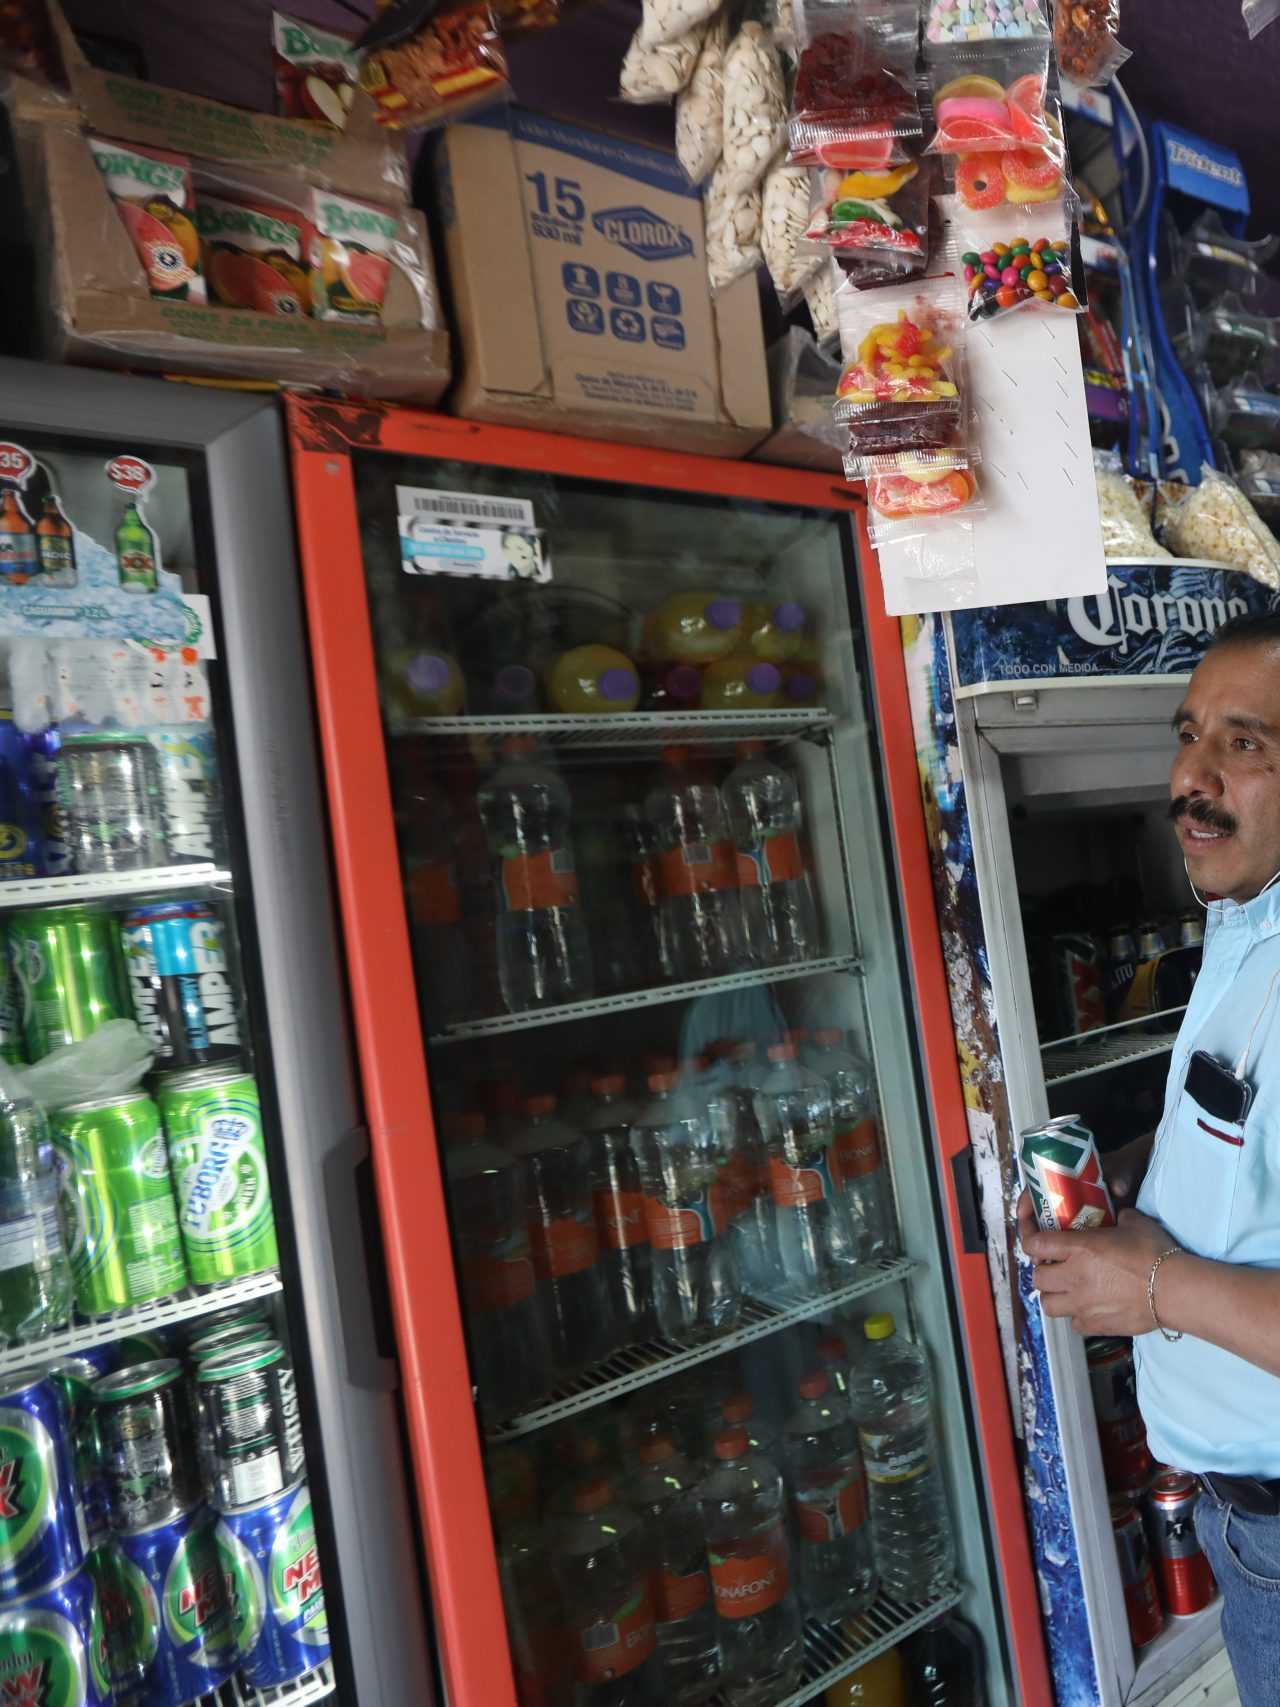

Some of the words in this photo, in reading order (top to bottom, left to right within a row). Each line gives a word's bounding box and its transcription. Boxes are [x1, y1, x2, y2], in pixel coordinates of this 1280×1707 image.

[97, 152, 186, 188] OING!
[1168, 140, 1242, 188] Trident
[525, 171, 585, 222] 15
[603, 218, 684, 249] CLOROX
[1000, 664, 1030, 675] TODO
[1033, 664, 1057, 674] CON
[1059, 662, 1099, 673] MEDIDA
[165, 738, 215, 858] AMPE
[283, 1545, 320, 1592] NE
